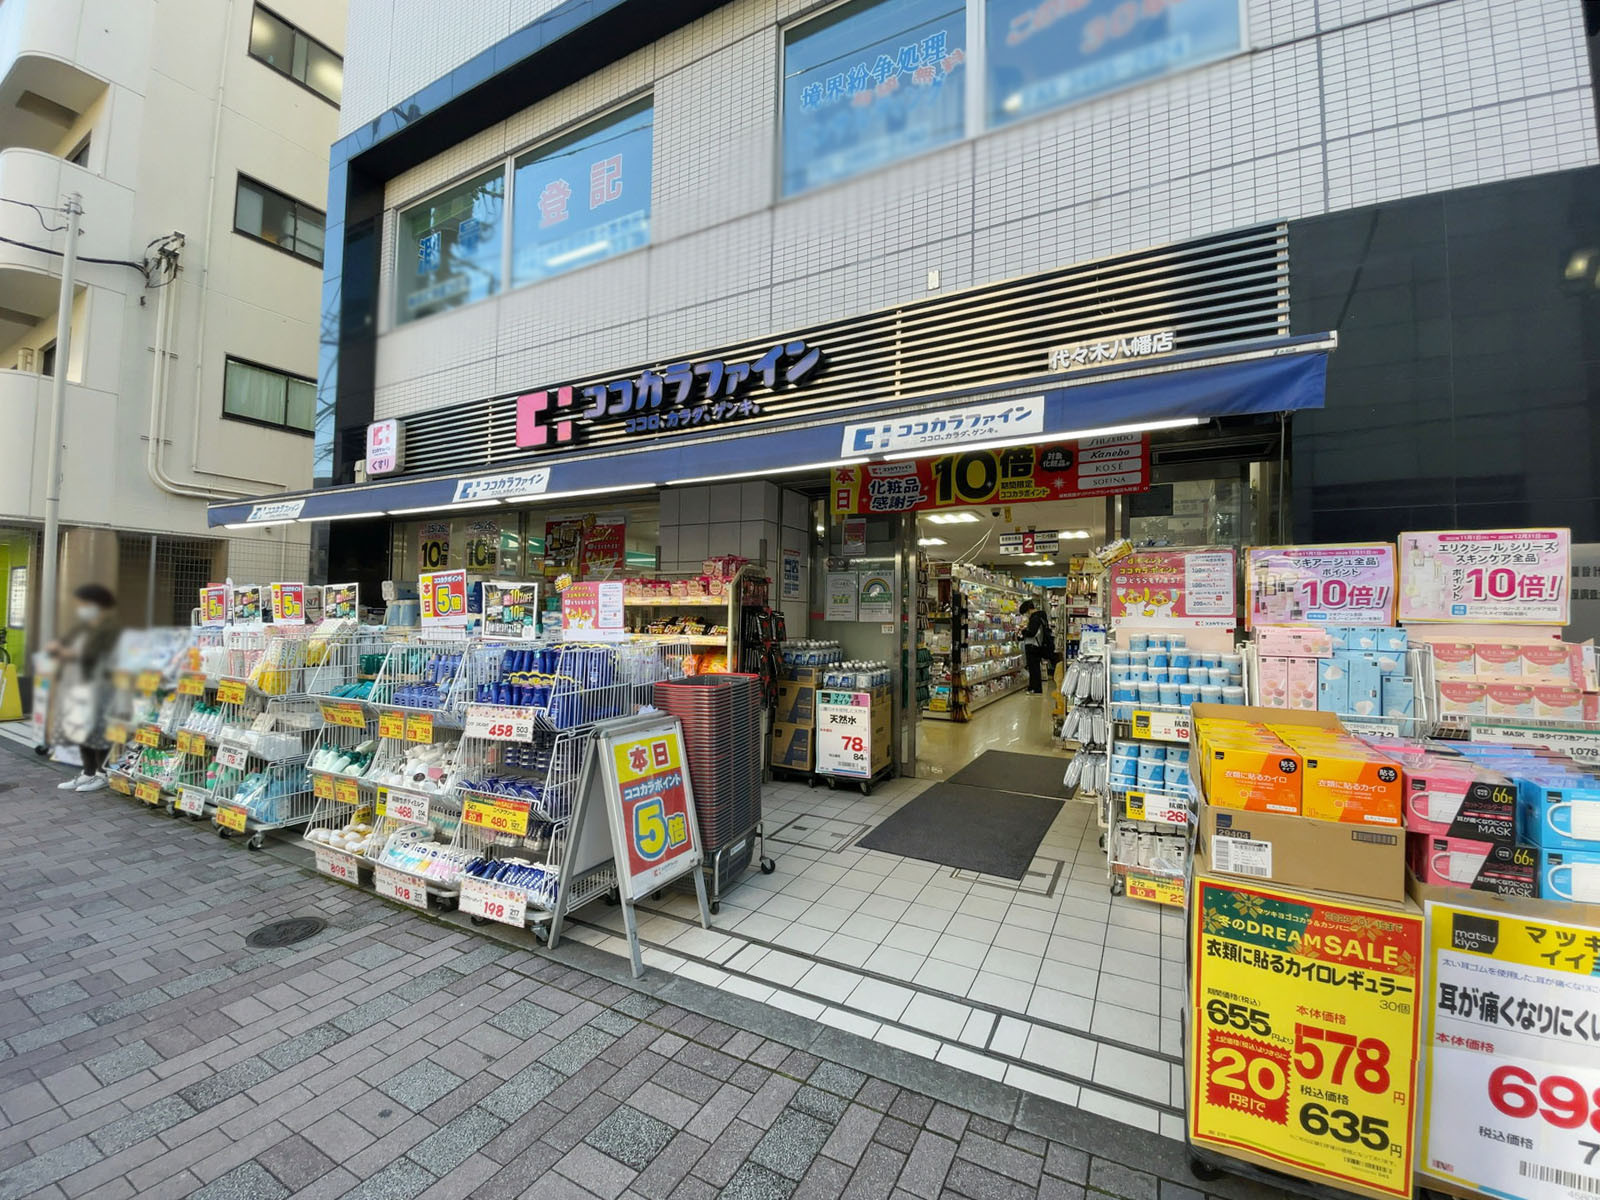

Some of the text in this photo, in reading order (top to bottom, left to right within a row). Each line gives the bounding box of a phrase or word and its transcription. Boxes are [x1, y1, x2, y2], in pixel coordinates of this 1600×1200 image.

[800, 30, 947, 111] 境界紛争処理
[538, 154, 623, 229] 登記
[1051, 331, 1175, 371] 代々木八幡店
[583, 340, 822, 420] ココカラファイン
[897, 406, 1032, 438] ココカラファイン
[919, 428, 999, 443] ココロ、カラダ、ゲンキ。
[1090, 448, 1130, 460] Kanebo
[371, 458, 389, 471] くすり
[1095, 462, 1124, 473] KOSÉ
[481, 474, 544, 492] ココカラファイン
[835, 467, 856, 510] 本日
[870, 477, 920, 496] 化粧品
[1000, 479, 1033, 490] 期間限定
[1093, 476, 1126, 487] SOFINA
[1000, 487, 1049, 500] ココカラポイント
[871, 494, 928, 511] 感謝デー
[1024, 538, 1033, 549] 2
[1292, 557, 1378, 568] マキアージュ全品
[1456, 553, 1539, 564] スキンケア全品
[1119, 566, 1178, 575] ココカラポイント
[1322, 568, 1361, 577] ポイント
[1452, 569, 1464, 600] ポイント
[830, 714, 857, 725] 天然水
[488, 724, 513, 737] 458
[516, 726, 529, 734] 503
[1502, 730, 1526, 739] MASK
[841, 736, 864, 752] 78
[628, 743, 669, 773] 本日
[853, 753, 864, 761] 84
[1280, 760, 1295, 768] 貼る
[1224, 770, 1287, 784] 衣類に貼るカイロ
[1379, 769, 1395, 777] 貼る
[624, 774, 682, 801] ココカラポイント
[1317, 779, 1386, 793] 衣類に貼るカイロ
[491, 816, 508, 828] 480
[635, 798, 687, 860] 5倍
[1456, 815, 1513, 828] 耳が痛くなりにくい
[1478, 825, 1512, 837] MASK
[330, 864, 346, 877] 898
[394, 885, 410, 900] 198
[1498, 885, 1532, 898] MASK
[484, 902, 504, 918] 198
[1454, 929, 1497, 944] matsu
[1454, 939, 1479, 950] kiyo
[1207, 939, 1413, 996] 衣類に貼るカイロレギュラー
[1379, 1000, 1411, 1015] 30個
[1206, 999, 1272, 1037] 655
[1296, 1005, 1347, 1026] 本体価格
[1436, 1032, 1496, 1054] 本体価格
[1293, 1022, 1391, 1095] 578
[1210, 1047, 1287, 1101] 20
[1229, 1092, 1267, 1113] 円引で
[1300, 1084, 1350, 1106] 税込価格
[1487, 1065, 1600, 1135] 69
[1299, 1102, 1390, 1151] 635
[1479, 1125, 1534, 1151] 税込価格
